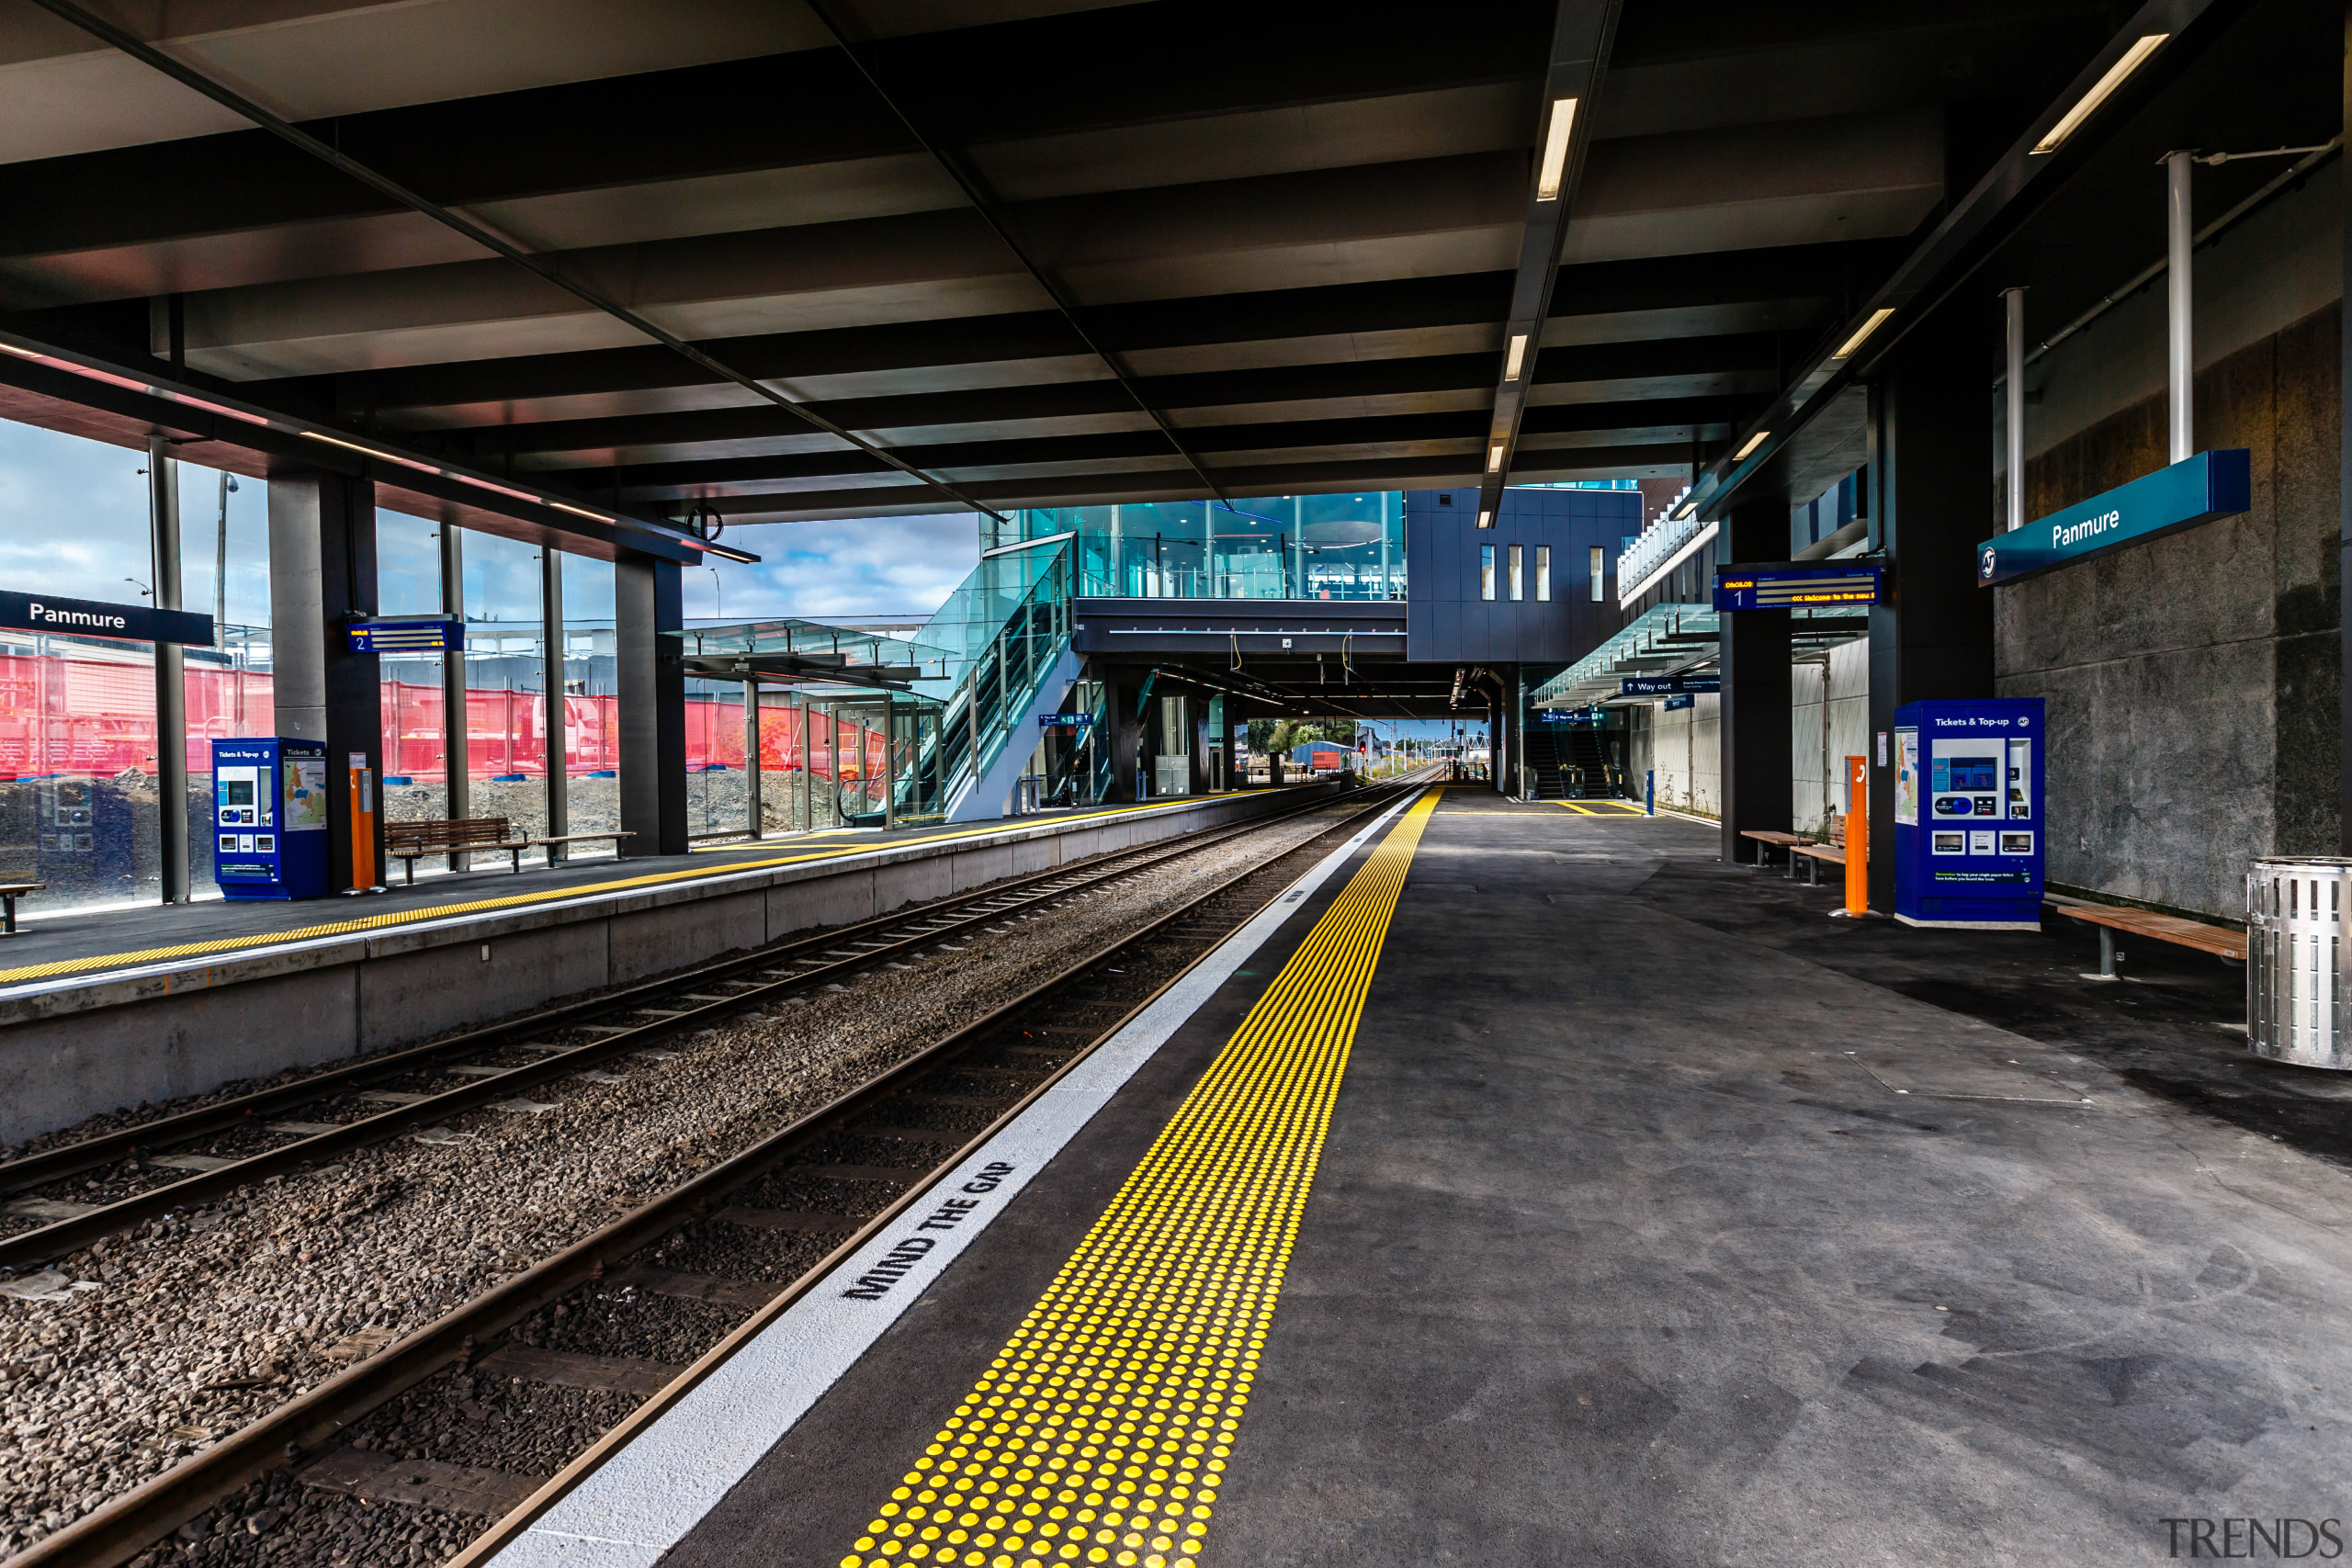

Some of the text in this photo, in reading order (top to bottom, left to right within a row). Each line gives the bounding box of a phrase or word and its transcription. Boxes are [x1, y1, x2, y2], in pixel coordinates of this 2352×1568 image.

[2052, 509, 2120, 549] Panmure
[1735, 591, 1742, 606] 1
[30, 603, 126, 629] Panmure
[356, 637, 365, 650] 2
[1637, 682, 1656, 693] Way
[1935, 717, 2009, 728] Tickets & Top-up
[842, 1161, 1016, 1301] MIND THE GAP
